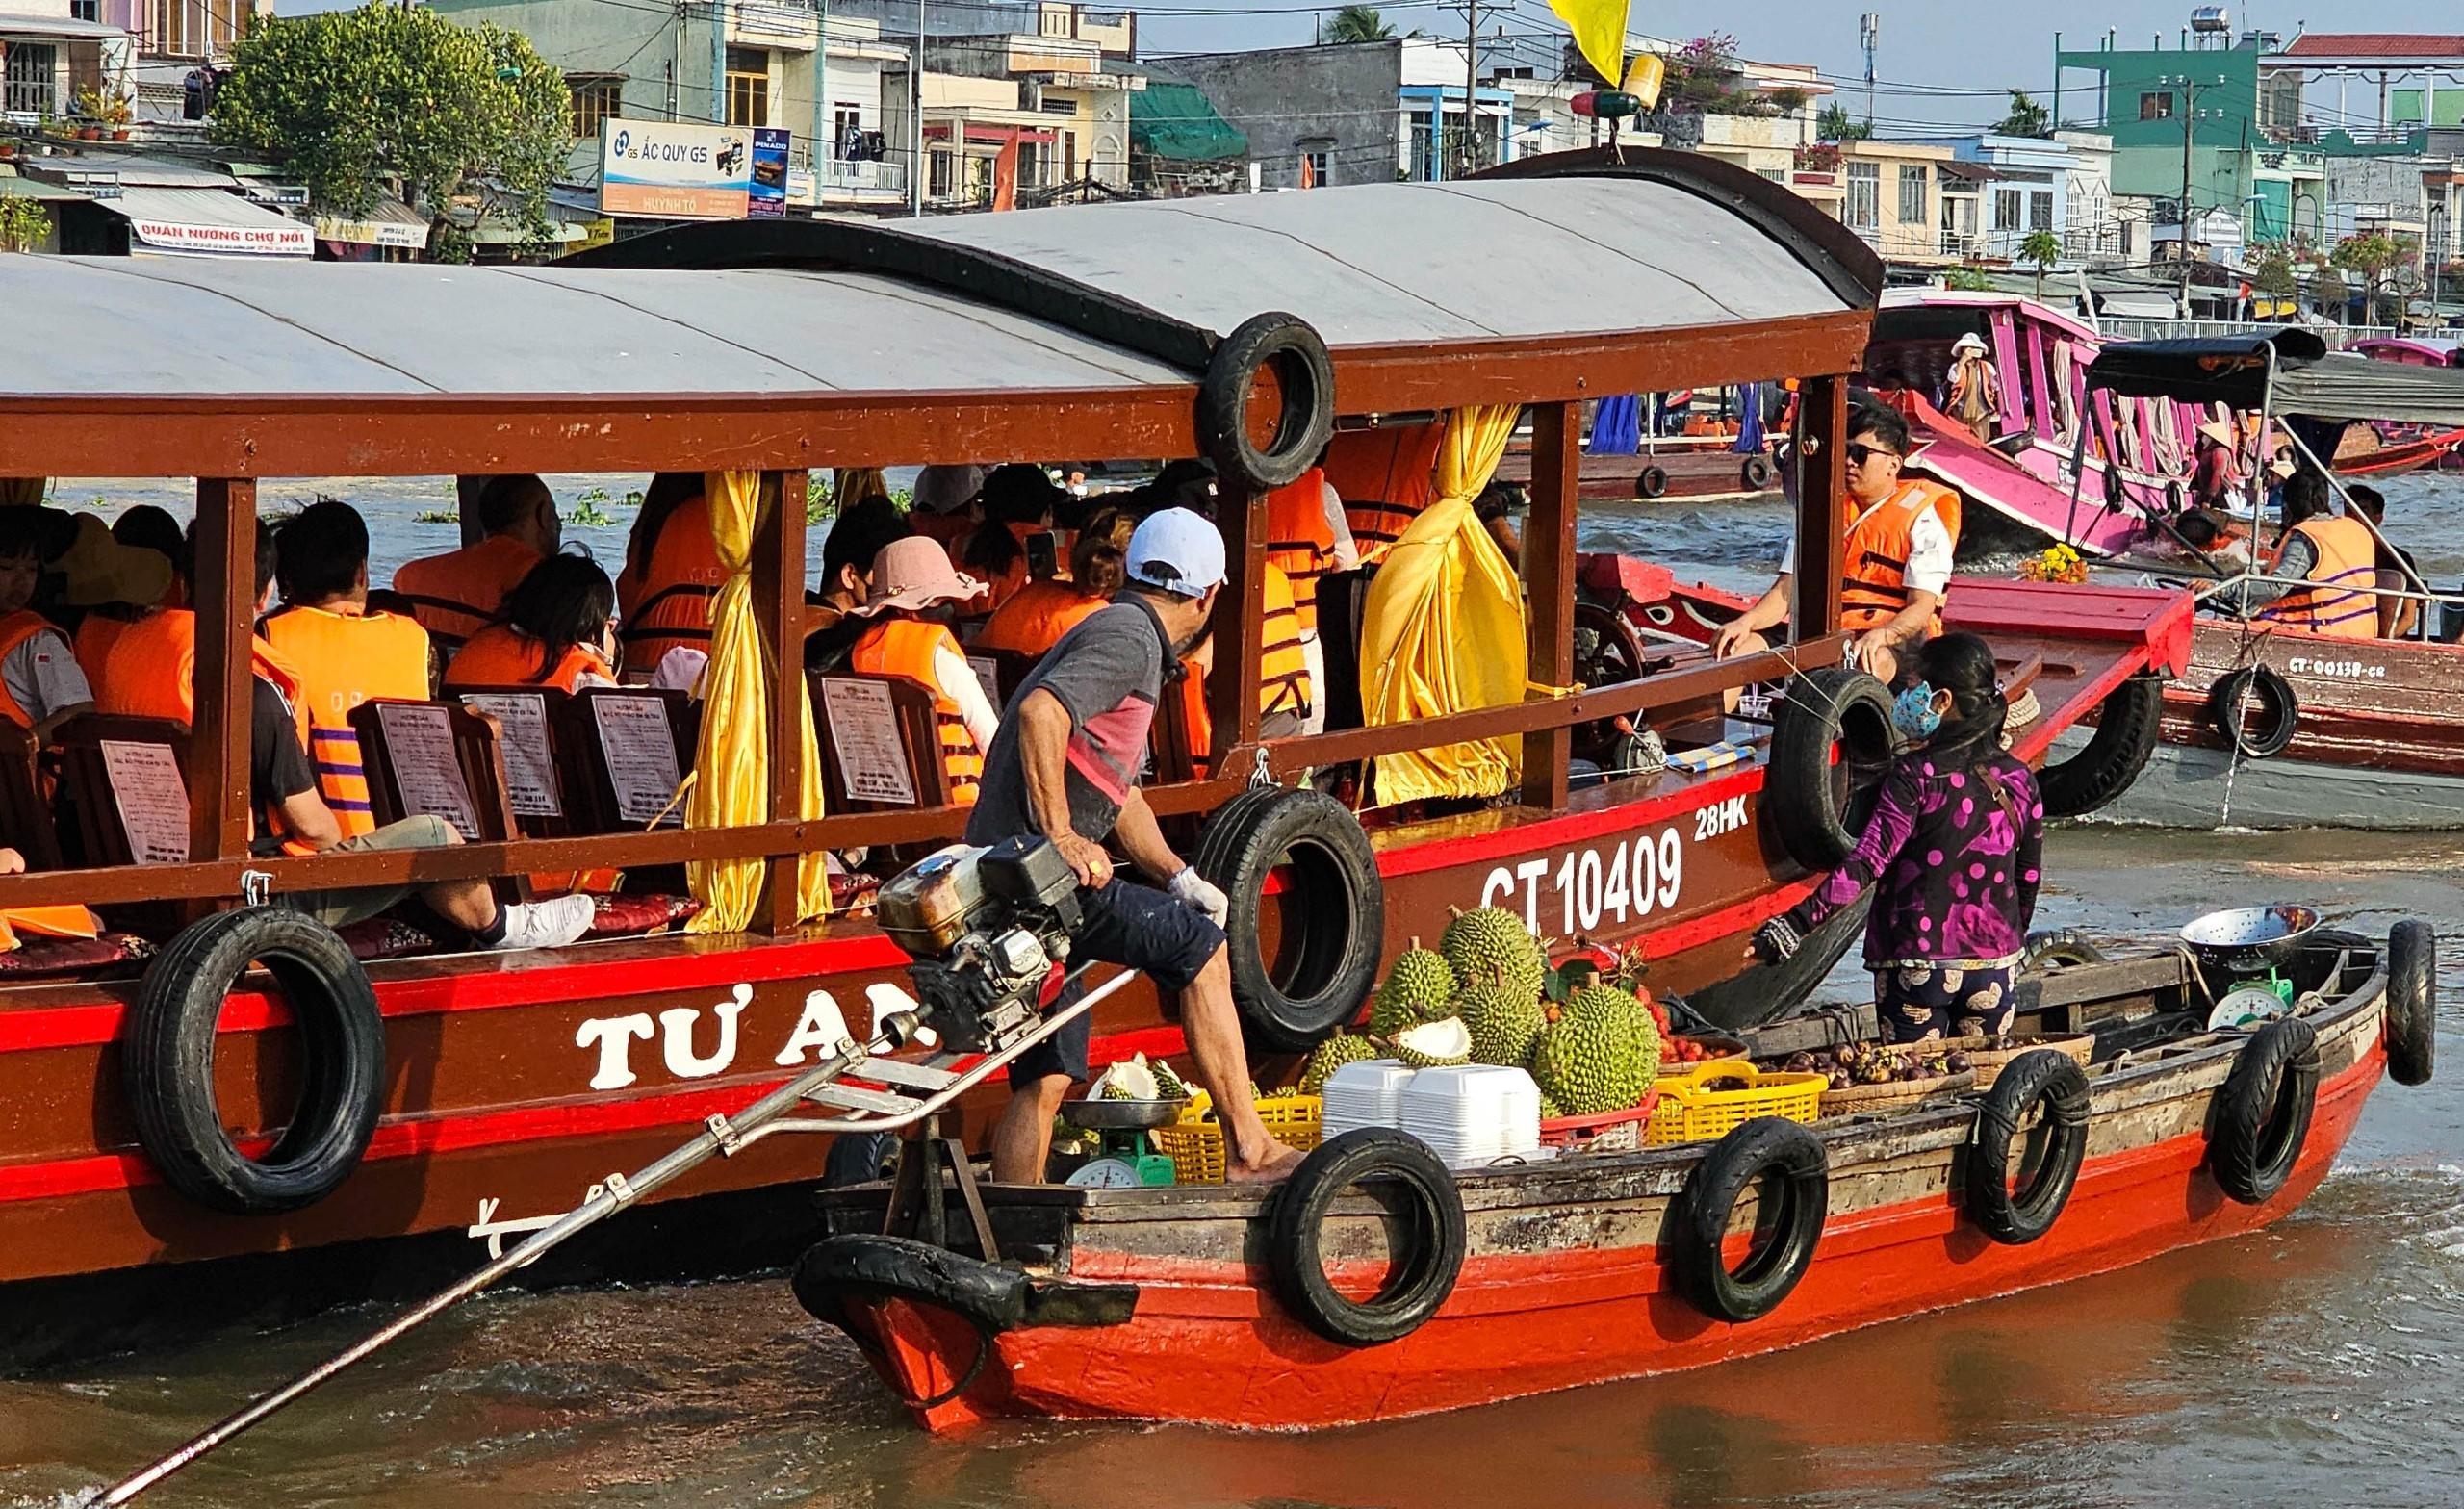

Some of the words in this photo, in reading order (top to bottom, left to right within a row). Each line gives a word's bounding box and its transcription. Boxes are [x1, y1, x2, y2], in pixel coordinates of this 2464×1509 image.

[662, 144, 688, 162] QUY
[690, 146, 707, 163] GS
[1694, 794, 1749, 842] 28HK
[575, 982, 754, 1091] TƯ
